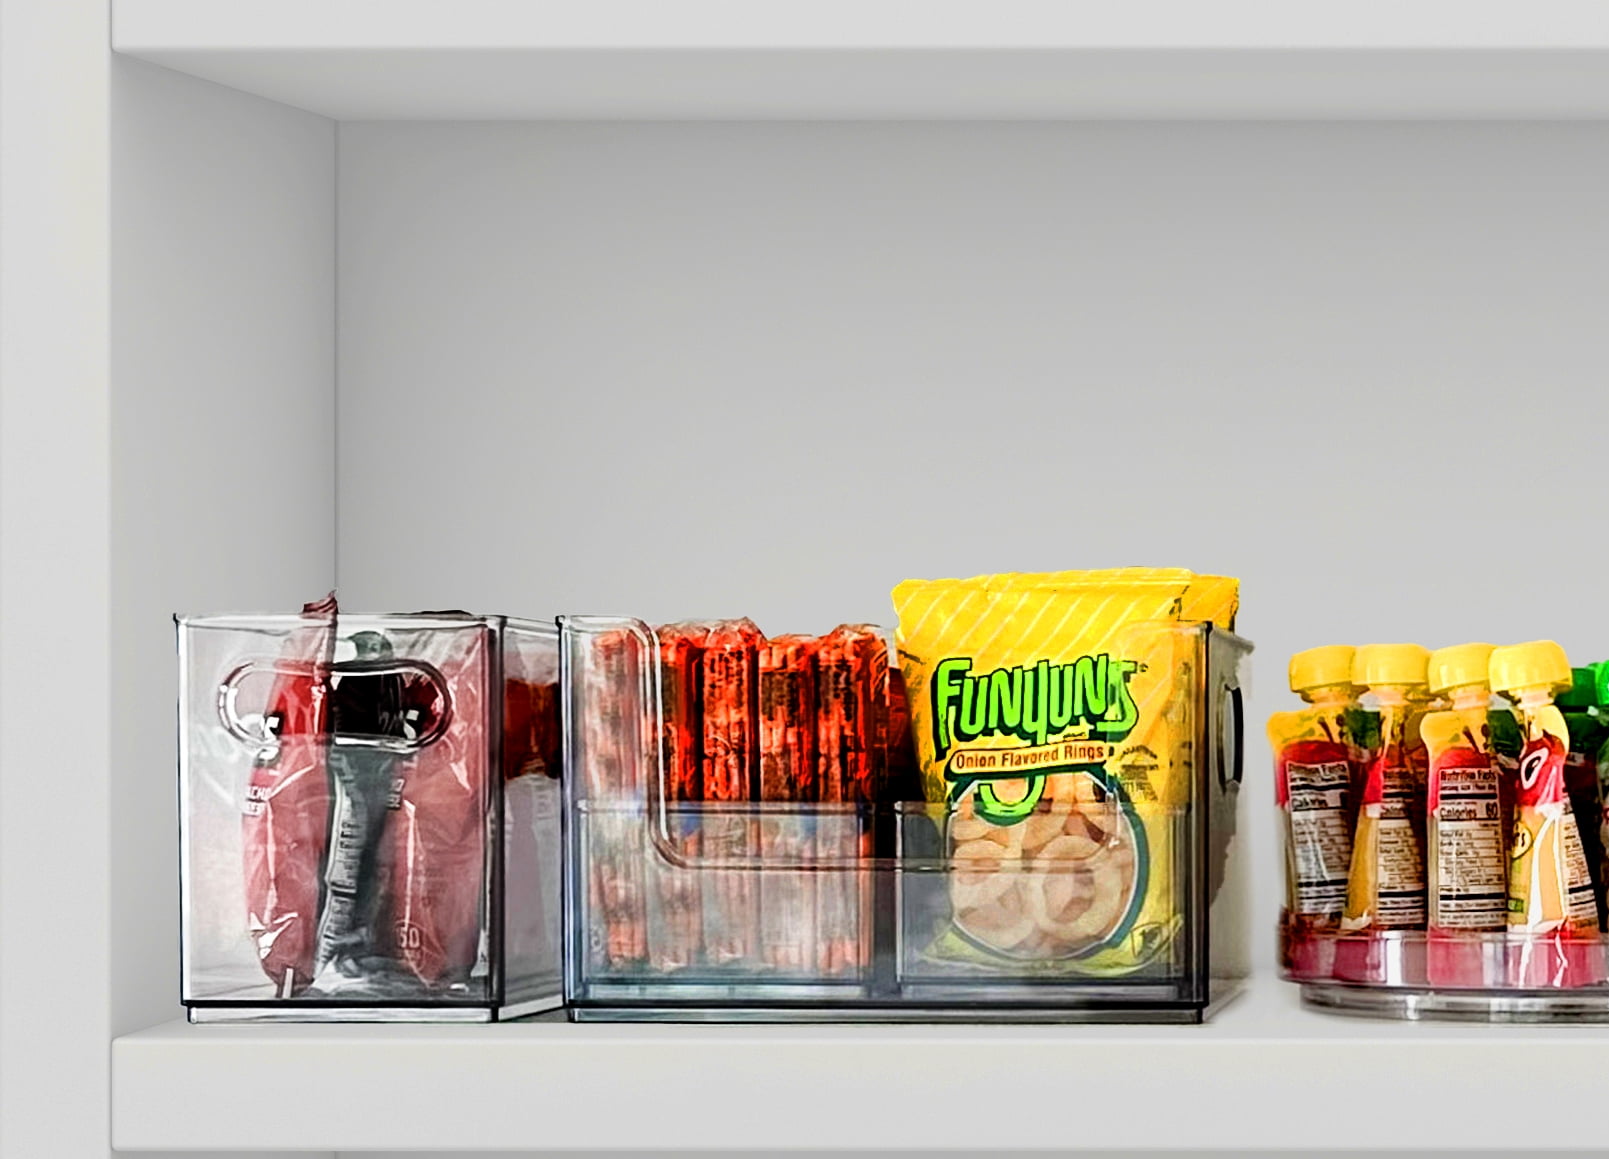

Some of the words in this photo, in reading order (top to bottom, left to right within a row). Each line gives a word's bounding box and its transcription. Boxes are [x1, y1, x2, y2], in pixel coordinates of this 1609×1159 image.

[956, 753, 996, 769] Onion
[1001, 746, 1059, 767] Flavored
[1064, 744, 1104, 762] Rings
